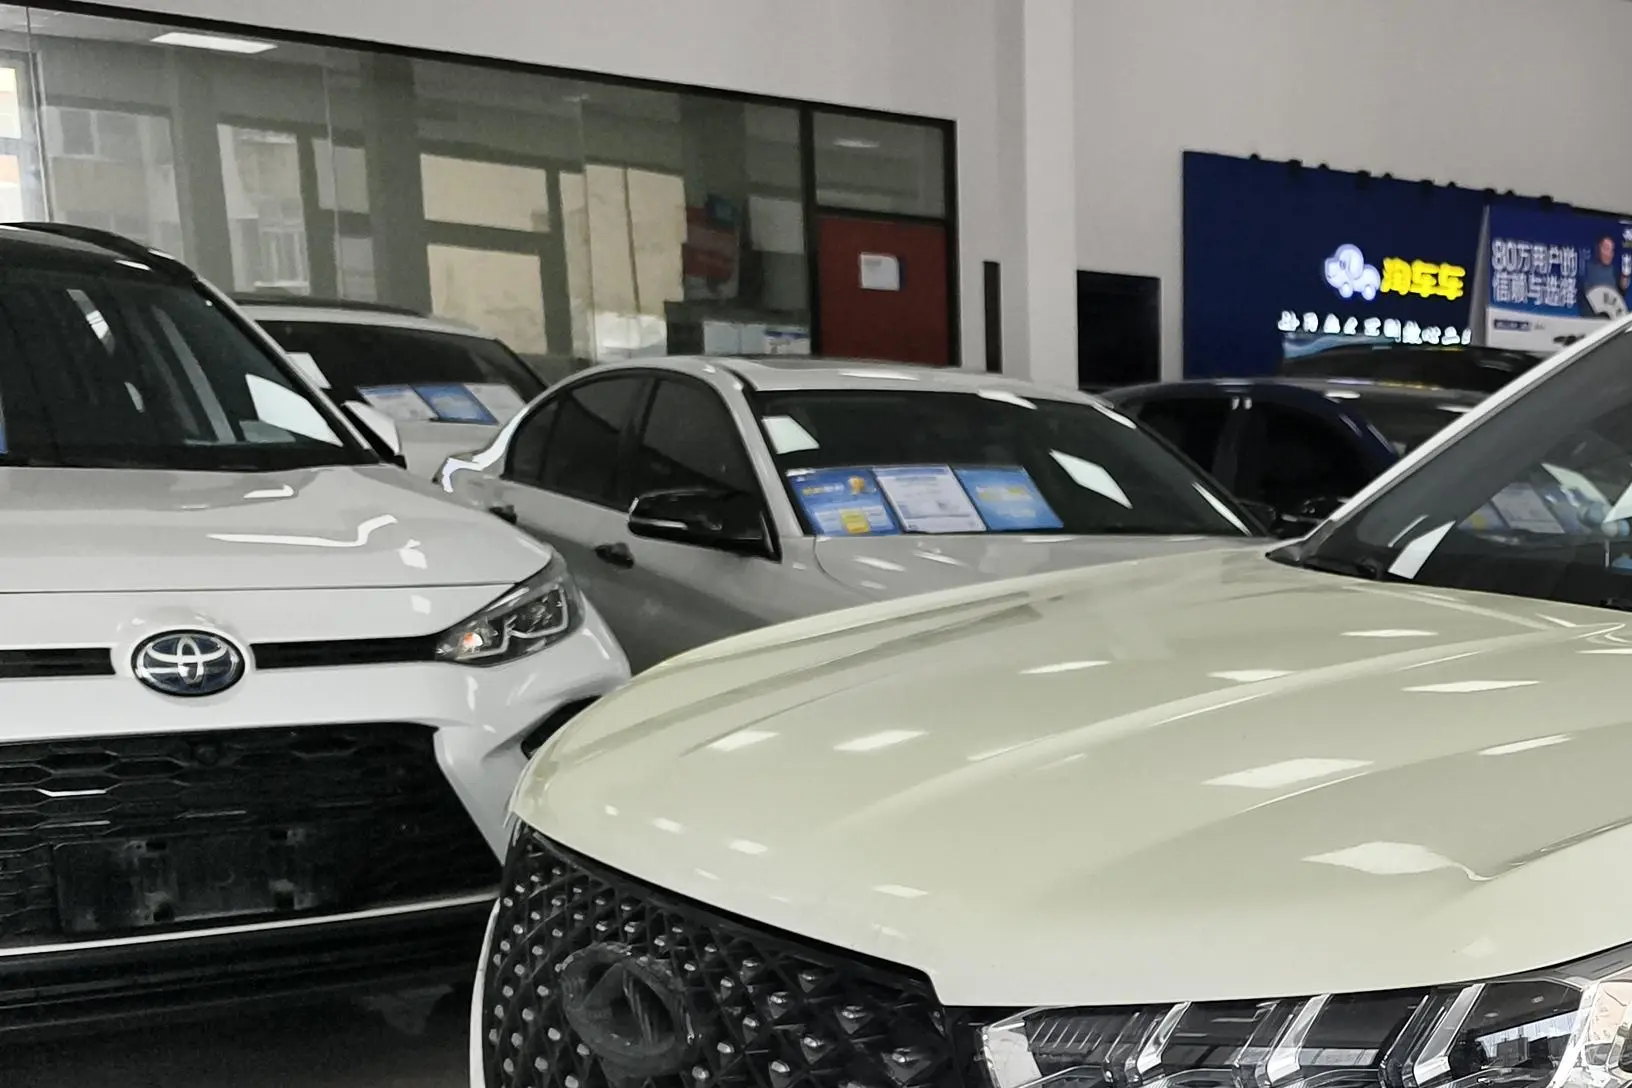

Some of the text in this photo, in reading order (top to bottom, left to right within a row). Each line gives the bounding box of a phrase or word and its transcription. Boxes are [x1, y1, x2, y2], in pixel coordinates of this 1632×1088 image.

[1491, 237, 1579, 276] 80万用户的
[1380, 257, 1466, 301] 淘车车
